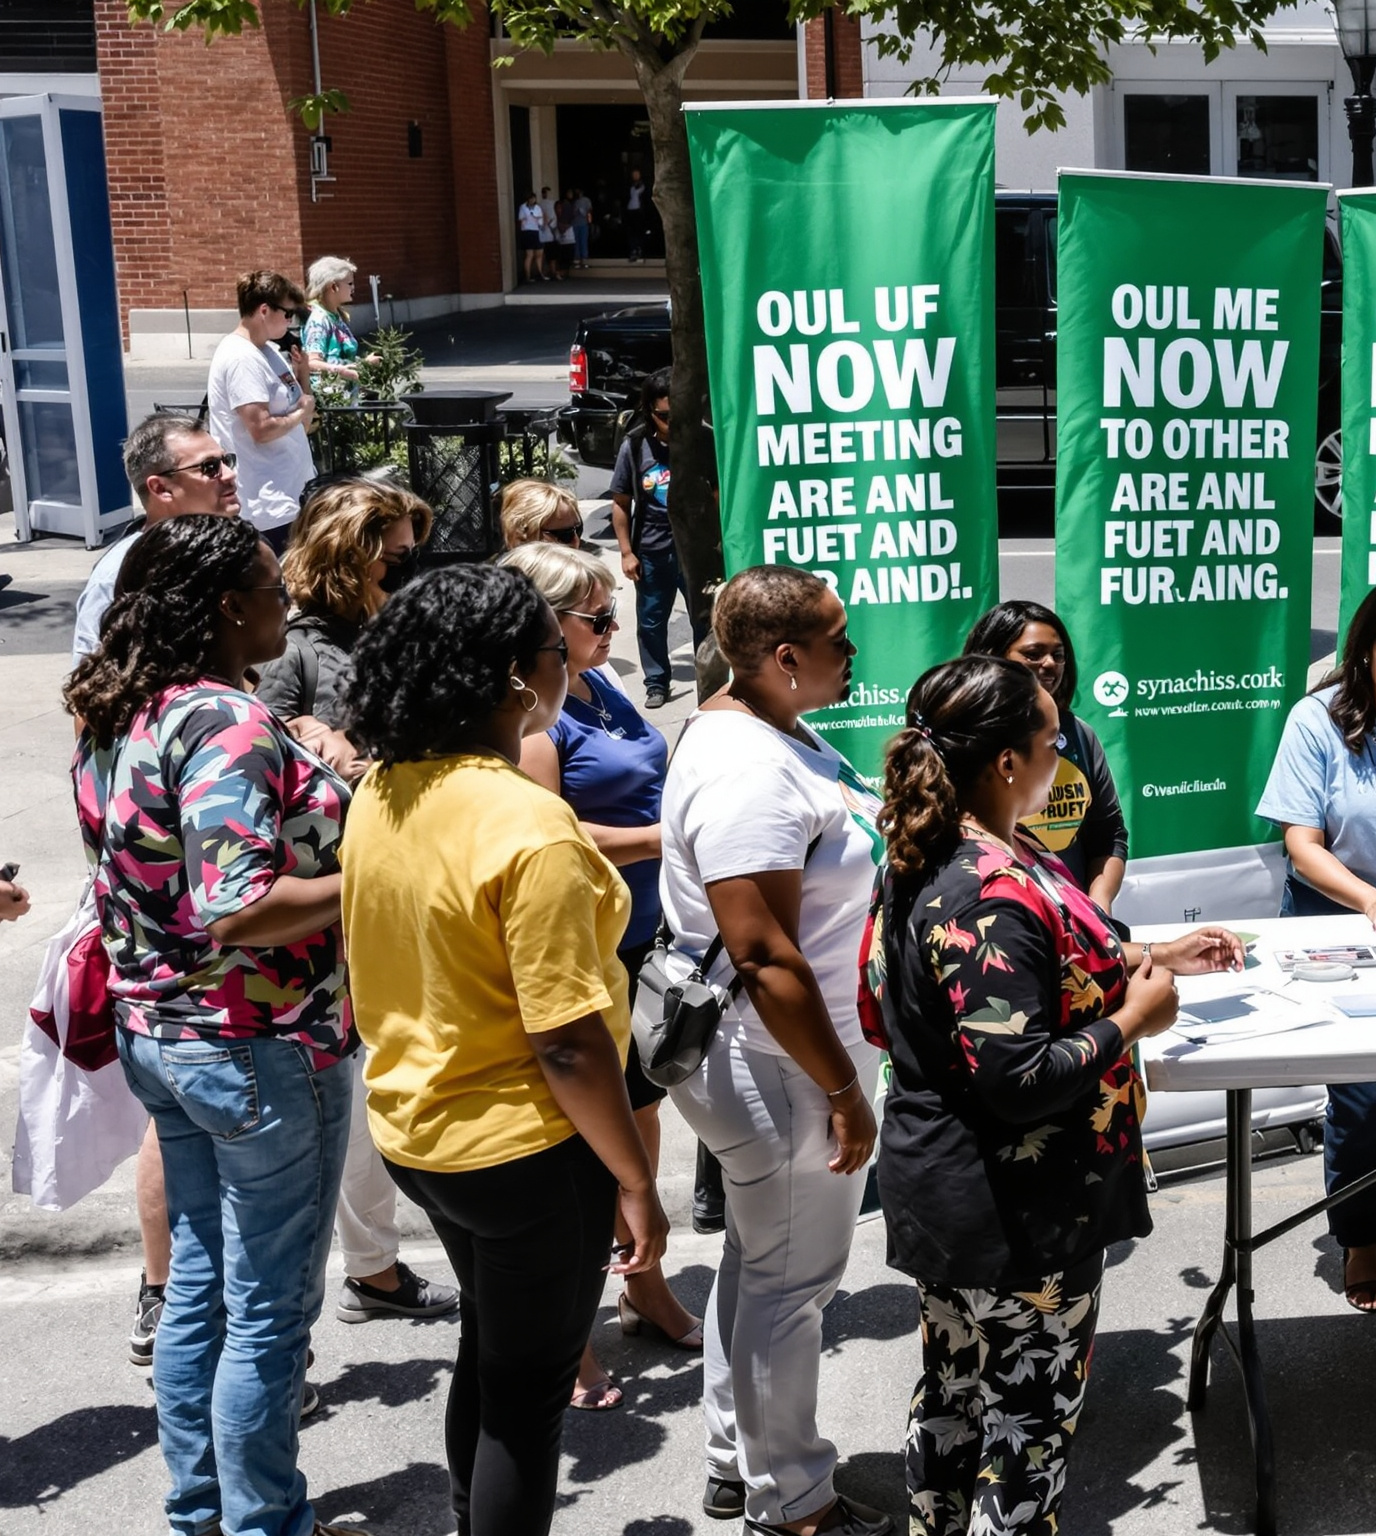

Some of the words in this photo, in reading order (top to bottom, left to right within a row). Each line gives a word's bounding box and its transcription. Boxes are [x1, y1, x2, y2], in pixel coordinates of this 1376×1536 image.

[757, 289, 860, 337] OUL
[875, 284, 940, 331] UF
[1112, 283, 1200, 329] OUL
[1213, 287, 1280, 330] ME
[753, 337, 957, 415] NOW
[1103, 337, 1290, 410] NOW
[757, 417, 962, 467] MEETING
[1100, 418, 1154, 460] TO
[1162, 418, 1289, 460] OTHER
[768, 477, 856, 520] ARE
[865, 472, 954, 514] ANL
[1110, 472, 1189, 512] ARE
[1196, 472, 1276, 511] ANL
[763, 523, 861, 565] FUET
[870, 519, 957, 559] AND
[1104, 519, 1194, 558] FUET
[1201, 519, 1280, 556] AND
[1188, 562, 1289, 602] AING.
